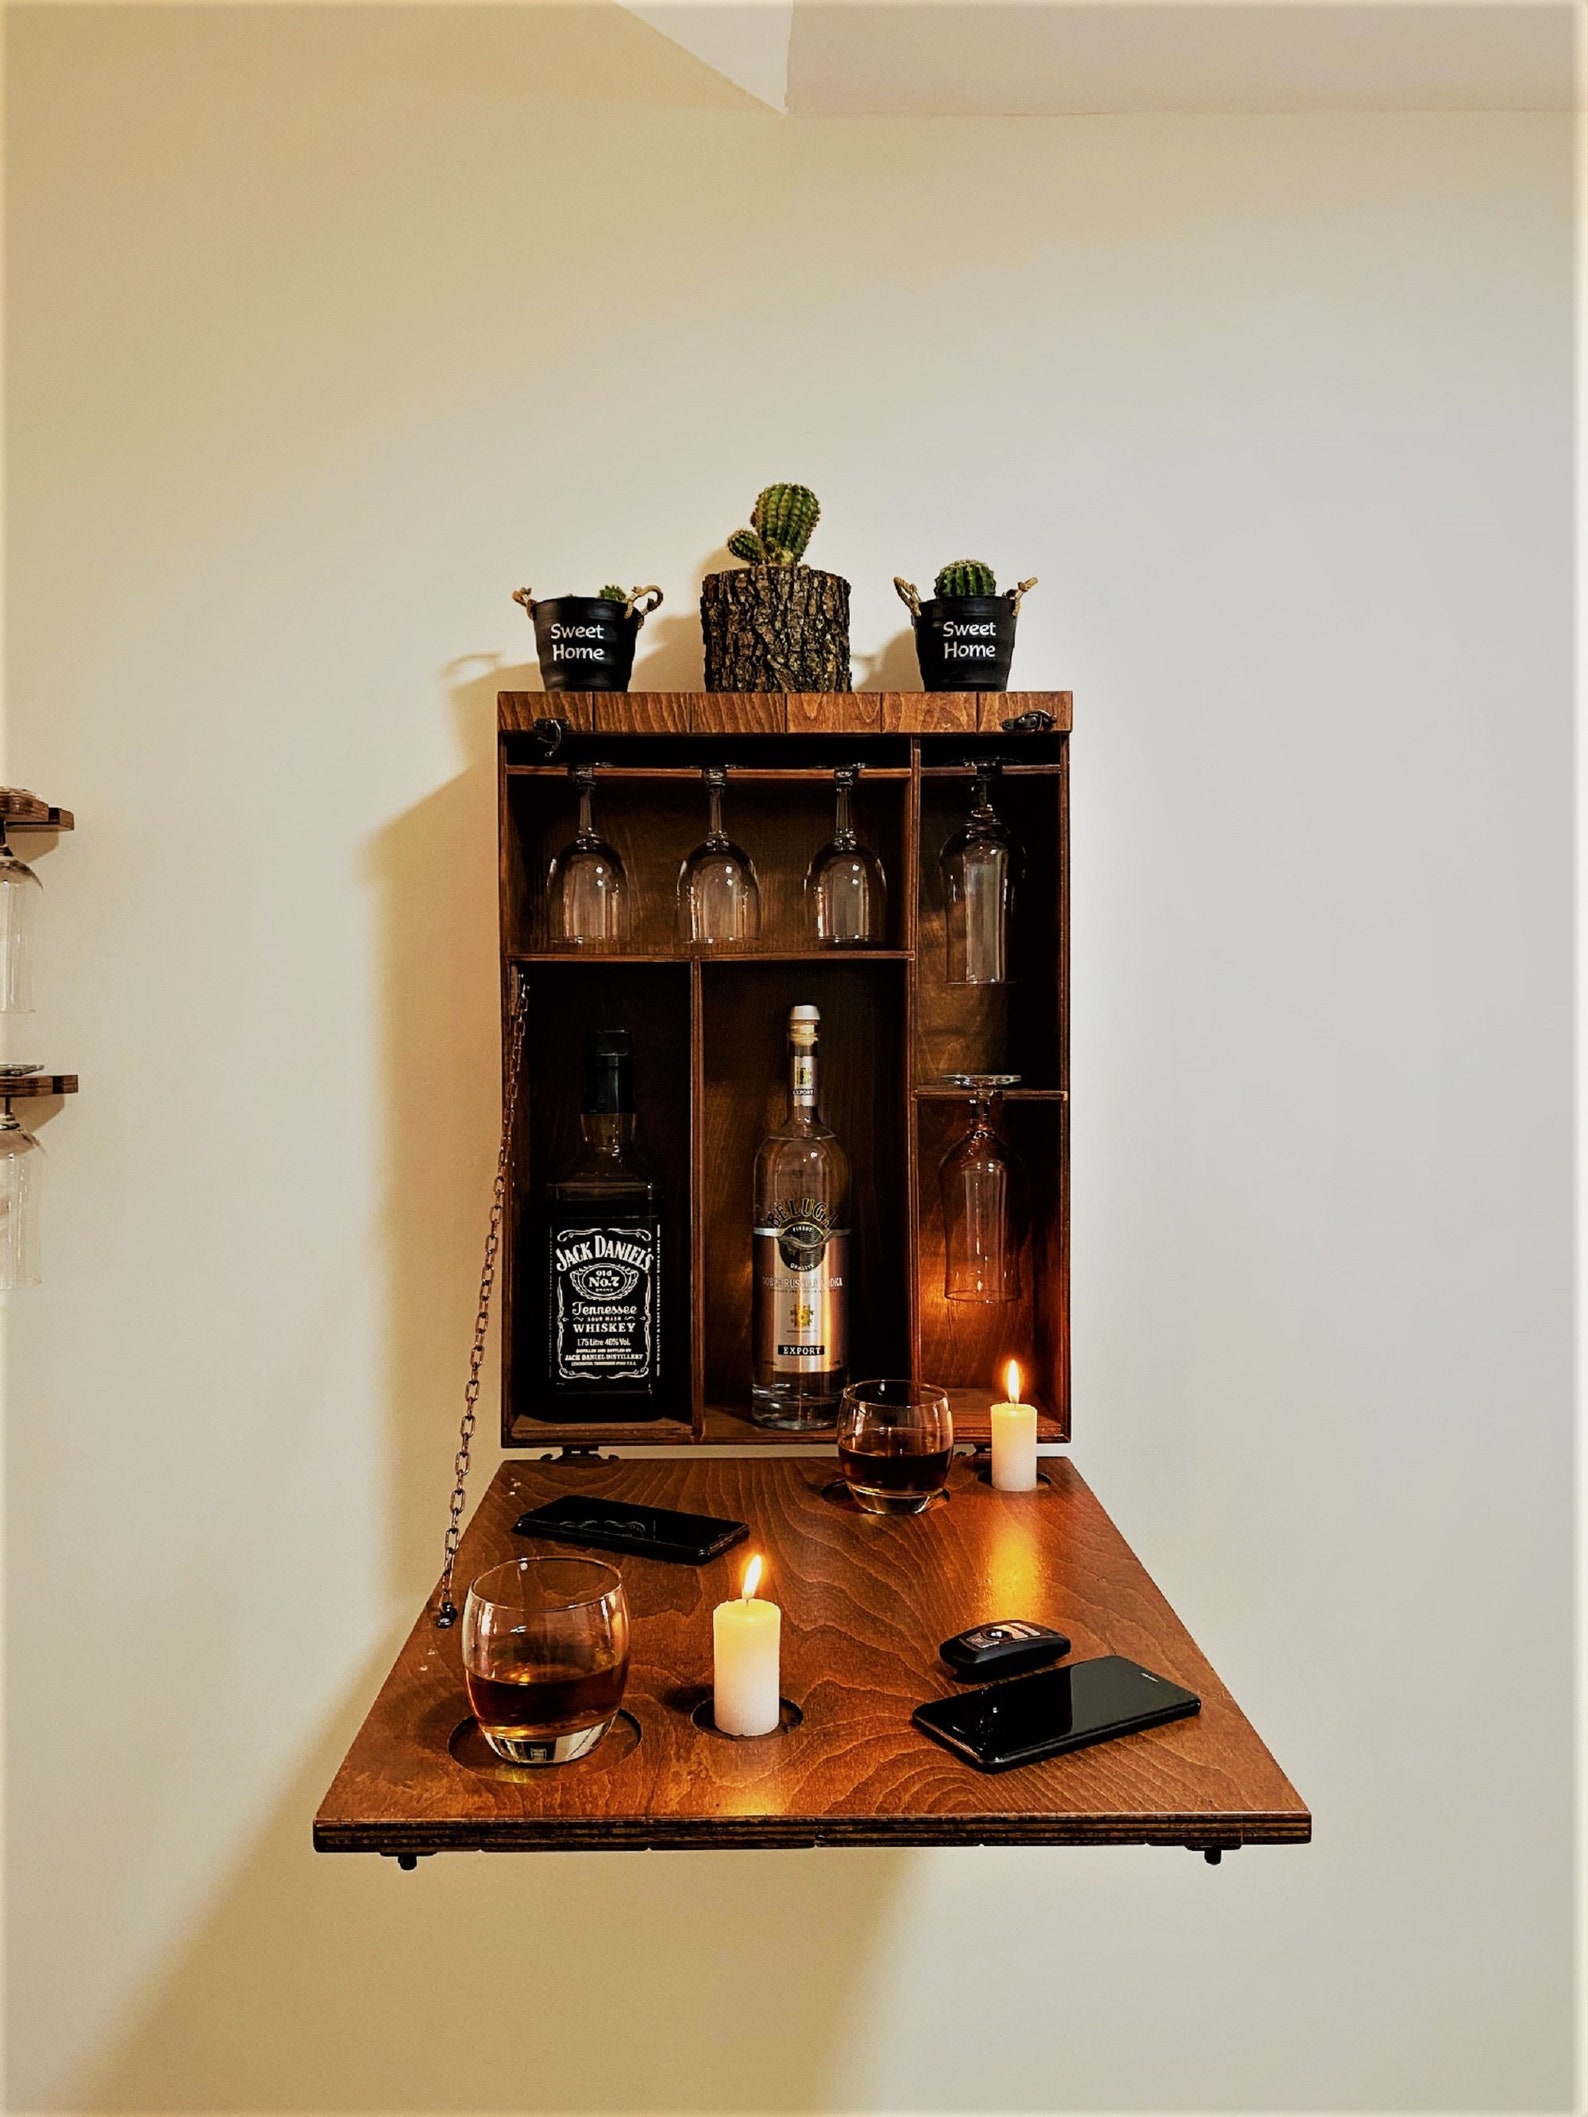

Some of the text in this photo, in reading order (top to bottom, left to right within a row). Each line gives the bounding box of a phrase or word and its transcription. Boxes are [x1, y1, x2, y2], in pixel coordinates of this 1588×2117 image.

[550, 623, 604, 639] Sweet
[943, 621, 996, 637] Sweet
[552, 644, 605, 661] Home
[943, 641, 996, 659] Home
[556, 1241, 594, 1272] JACK
[594, 1235, 655, 1273] DANIEL'S
[595, 1269, 613, 1277] Old
[588, 1276, 620, 1288] No.7
[572, 1301, 638, 1315] Tennessee
[573, 1322, 636, 1333] WHISKEY
[783, 1346, 822, 1355] EXPORT
